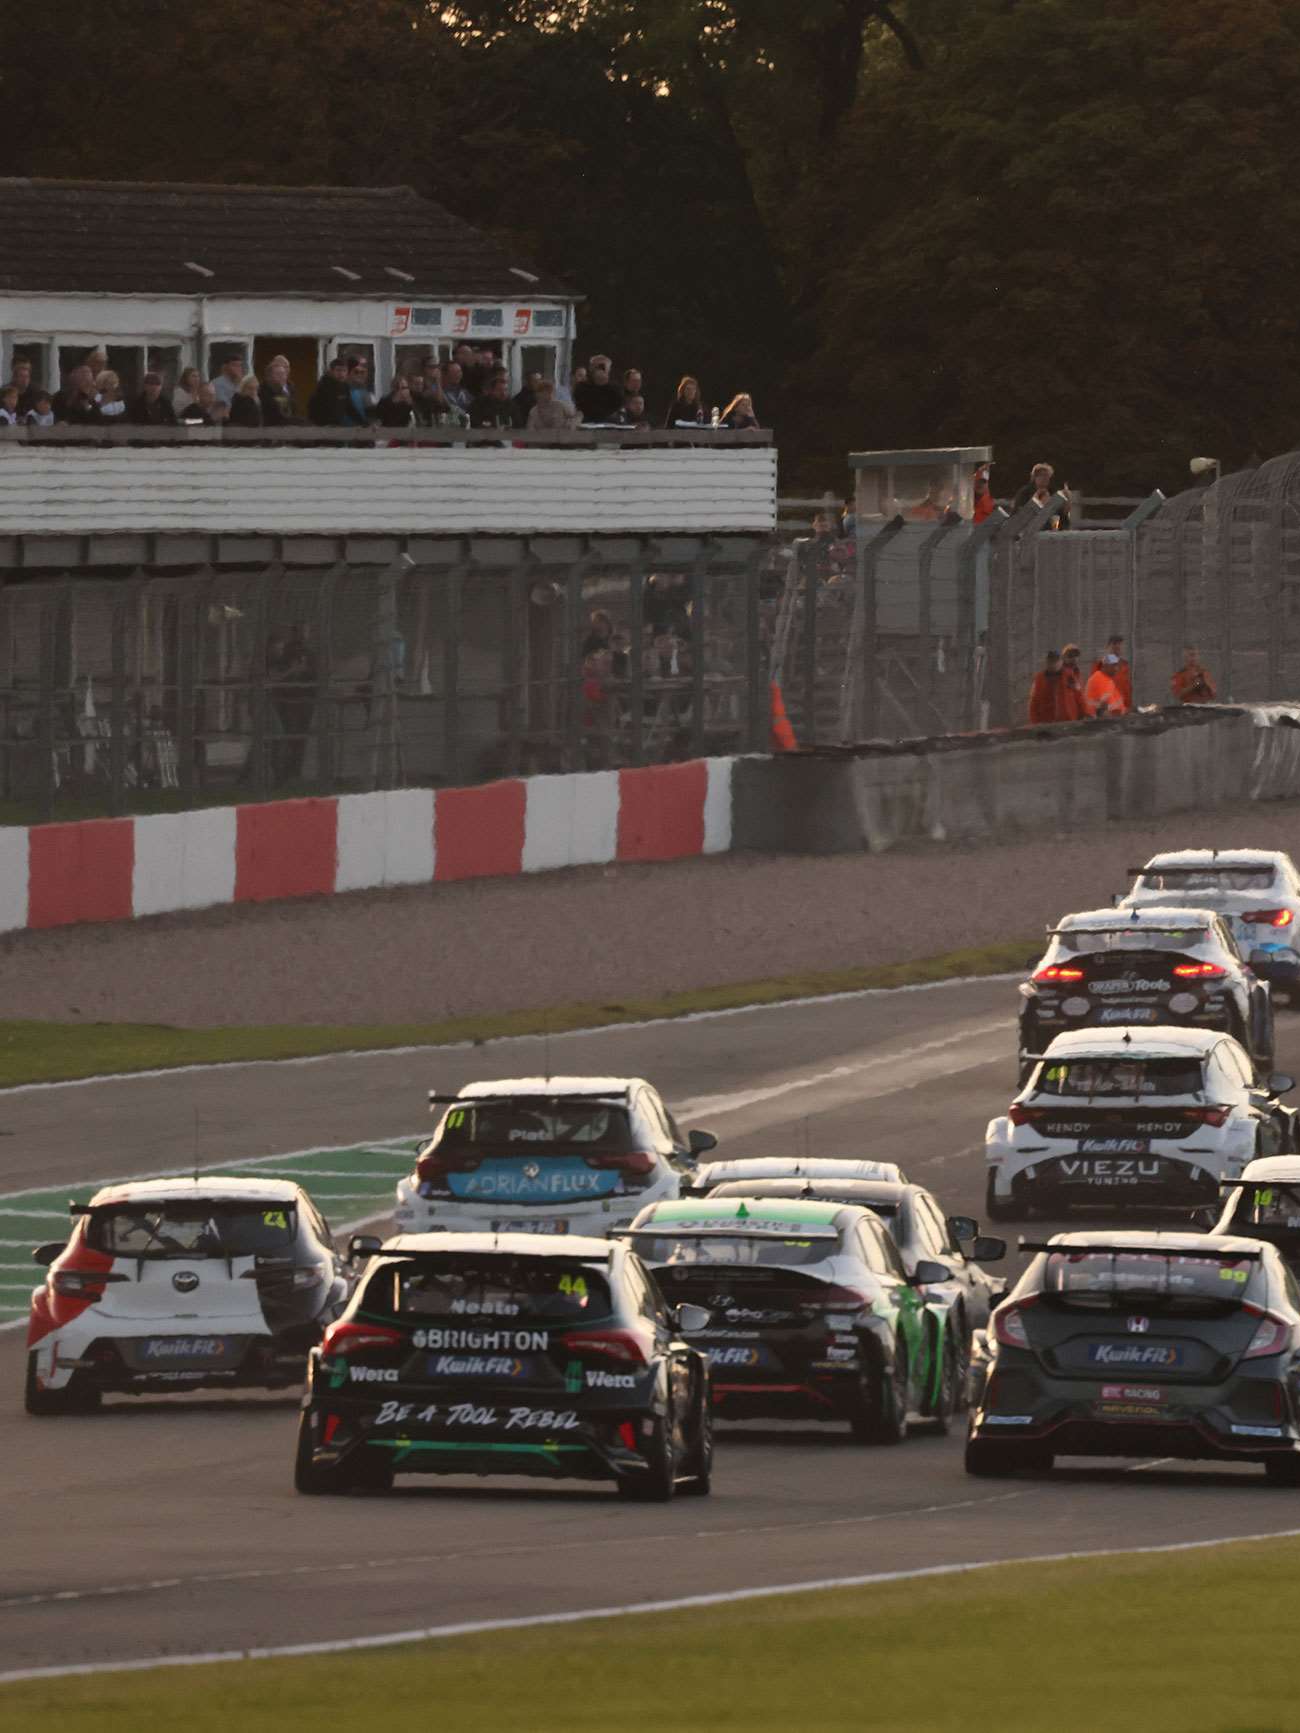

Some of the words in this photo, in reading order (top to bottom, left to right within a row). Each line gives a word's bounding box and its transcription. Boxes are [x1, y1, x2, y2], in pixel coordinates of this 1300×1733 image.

[1059, 1160, 1160, 1176] VIEZU
[559, 1273, 589, 1296] 44
[349, 1365, 400, 1384] Wera
[586, 1370, 635, 1390] Wera
[374, 1401, 409, 1425] BE
[417, 1404, 436, 1423] A
[446, 1402, 497, 1427] TOOL
[505, 1405, 580, 1430] REBEL
